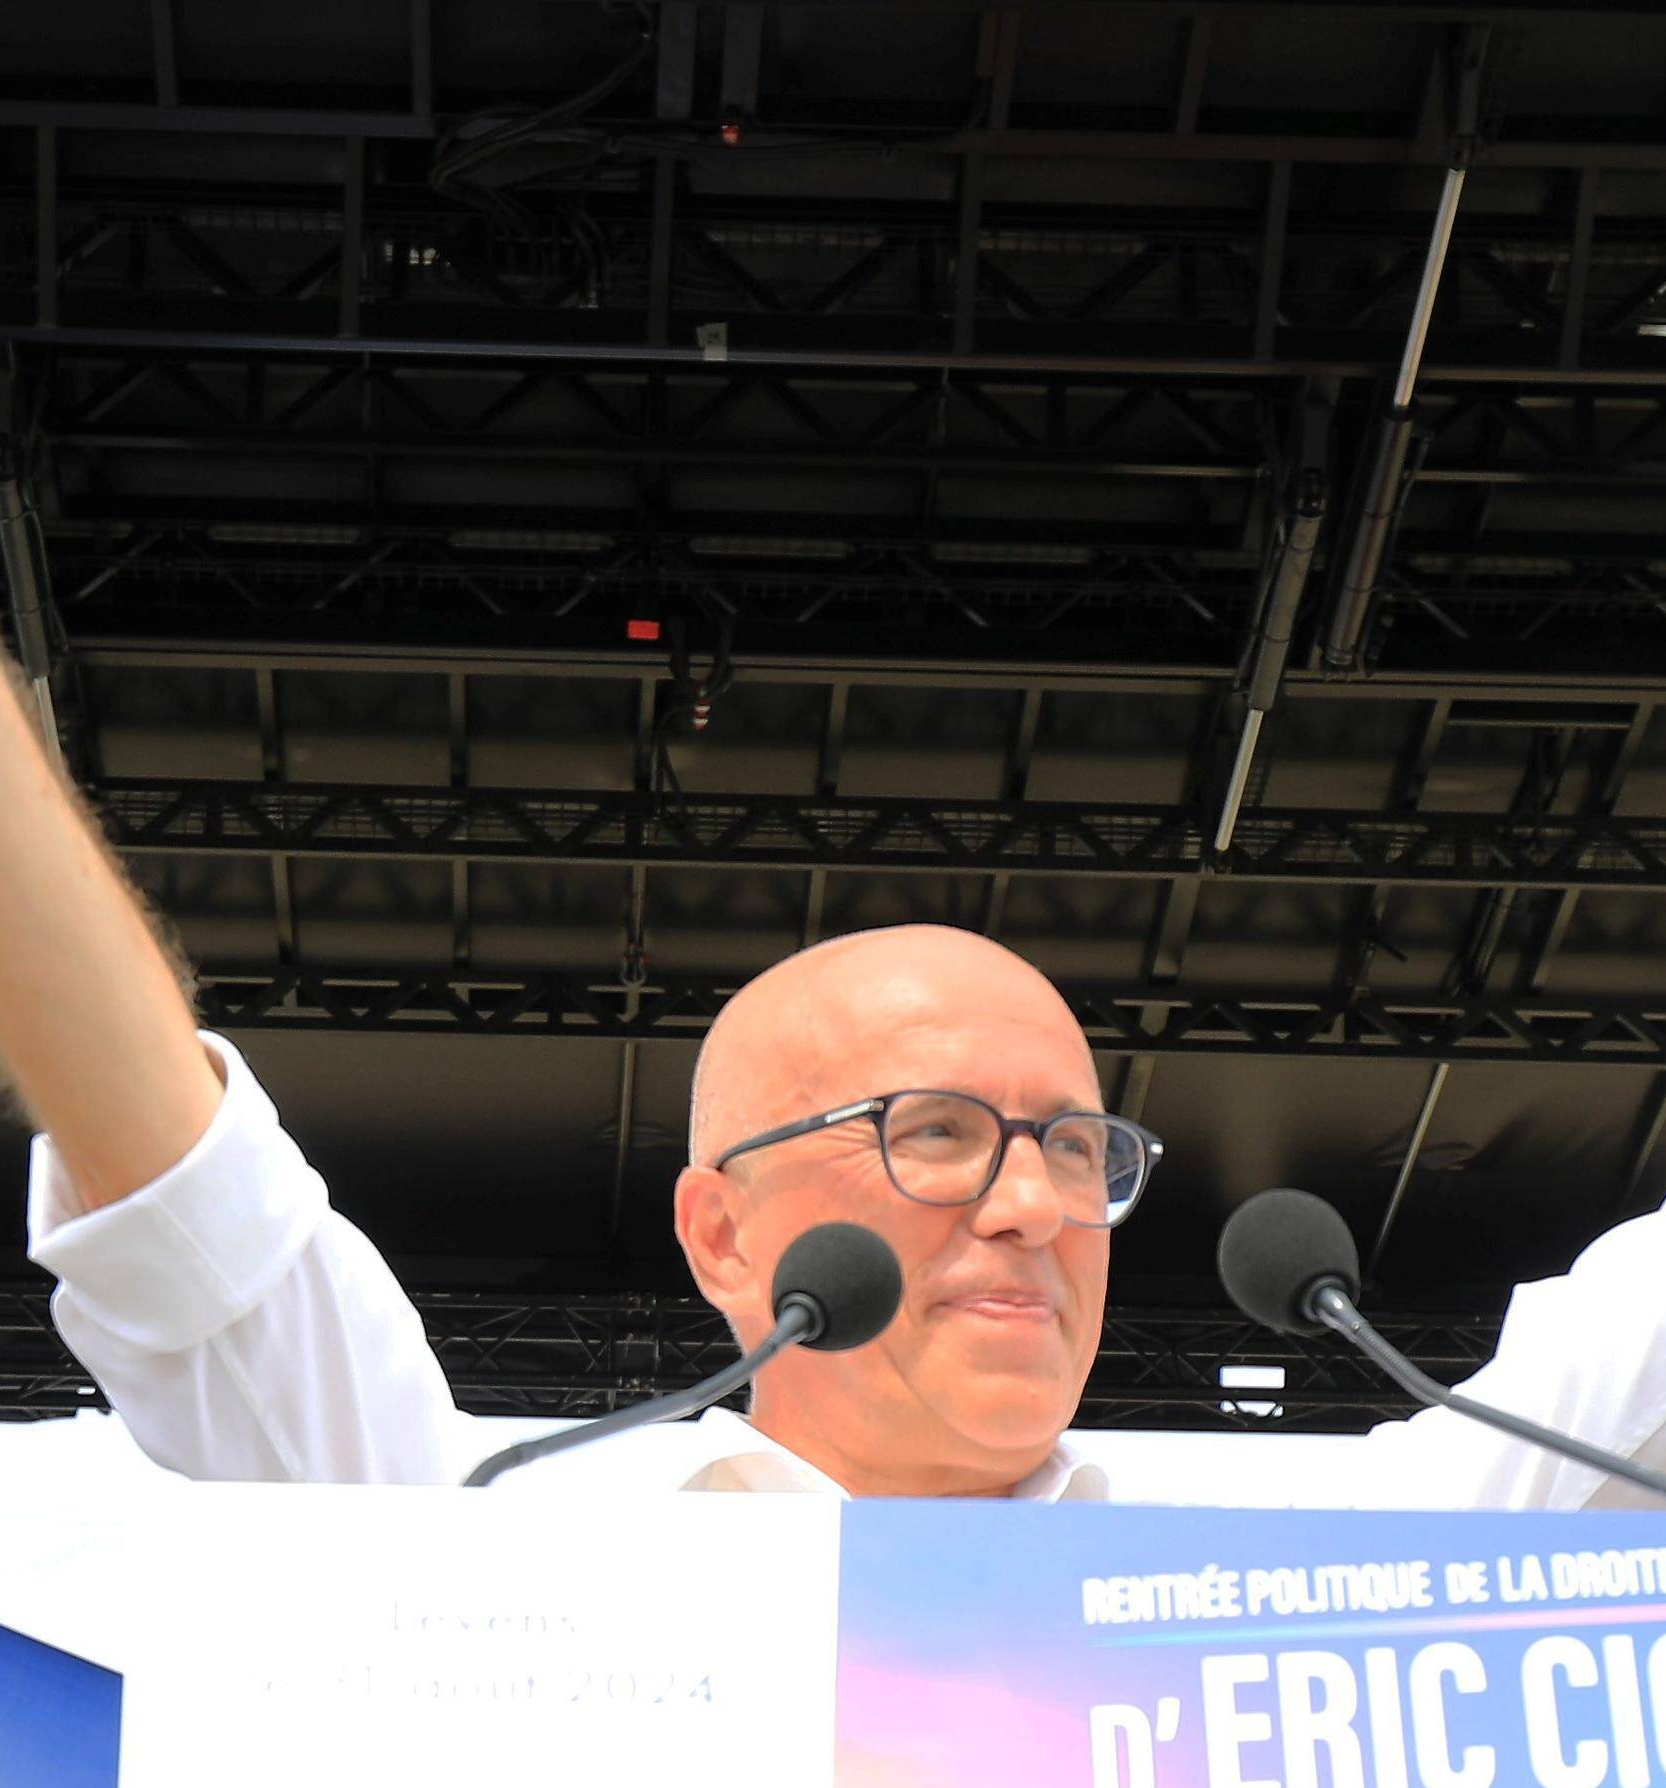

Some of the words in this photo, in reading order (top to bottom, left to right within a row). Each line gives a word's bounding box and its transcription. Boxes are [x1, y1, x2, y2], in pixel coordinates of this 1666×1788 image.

[1083, 1563, 1242, 1625] RENTRÉE
[1246, 1560, 1434, 1615] POLITIQUE
[1445, 1561, 1489, 1604] DE
[1499, 1555, 1548, 1603] LA
